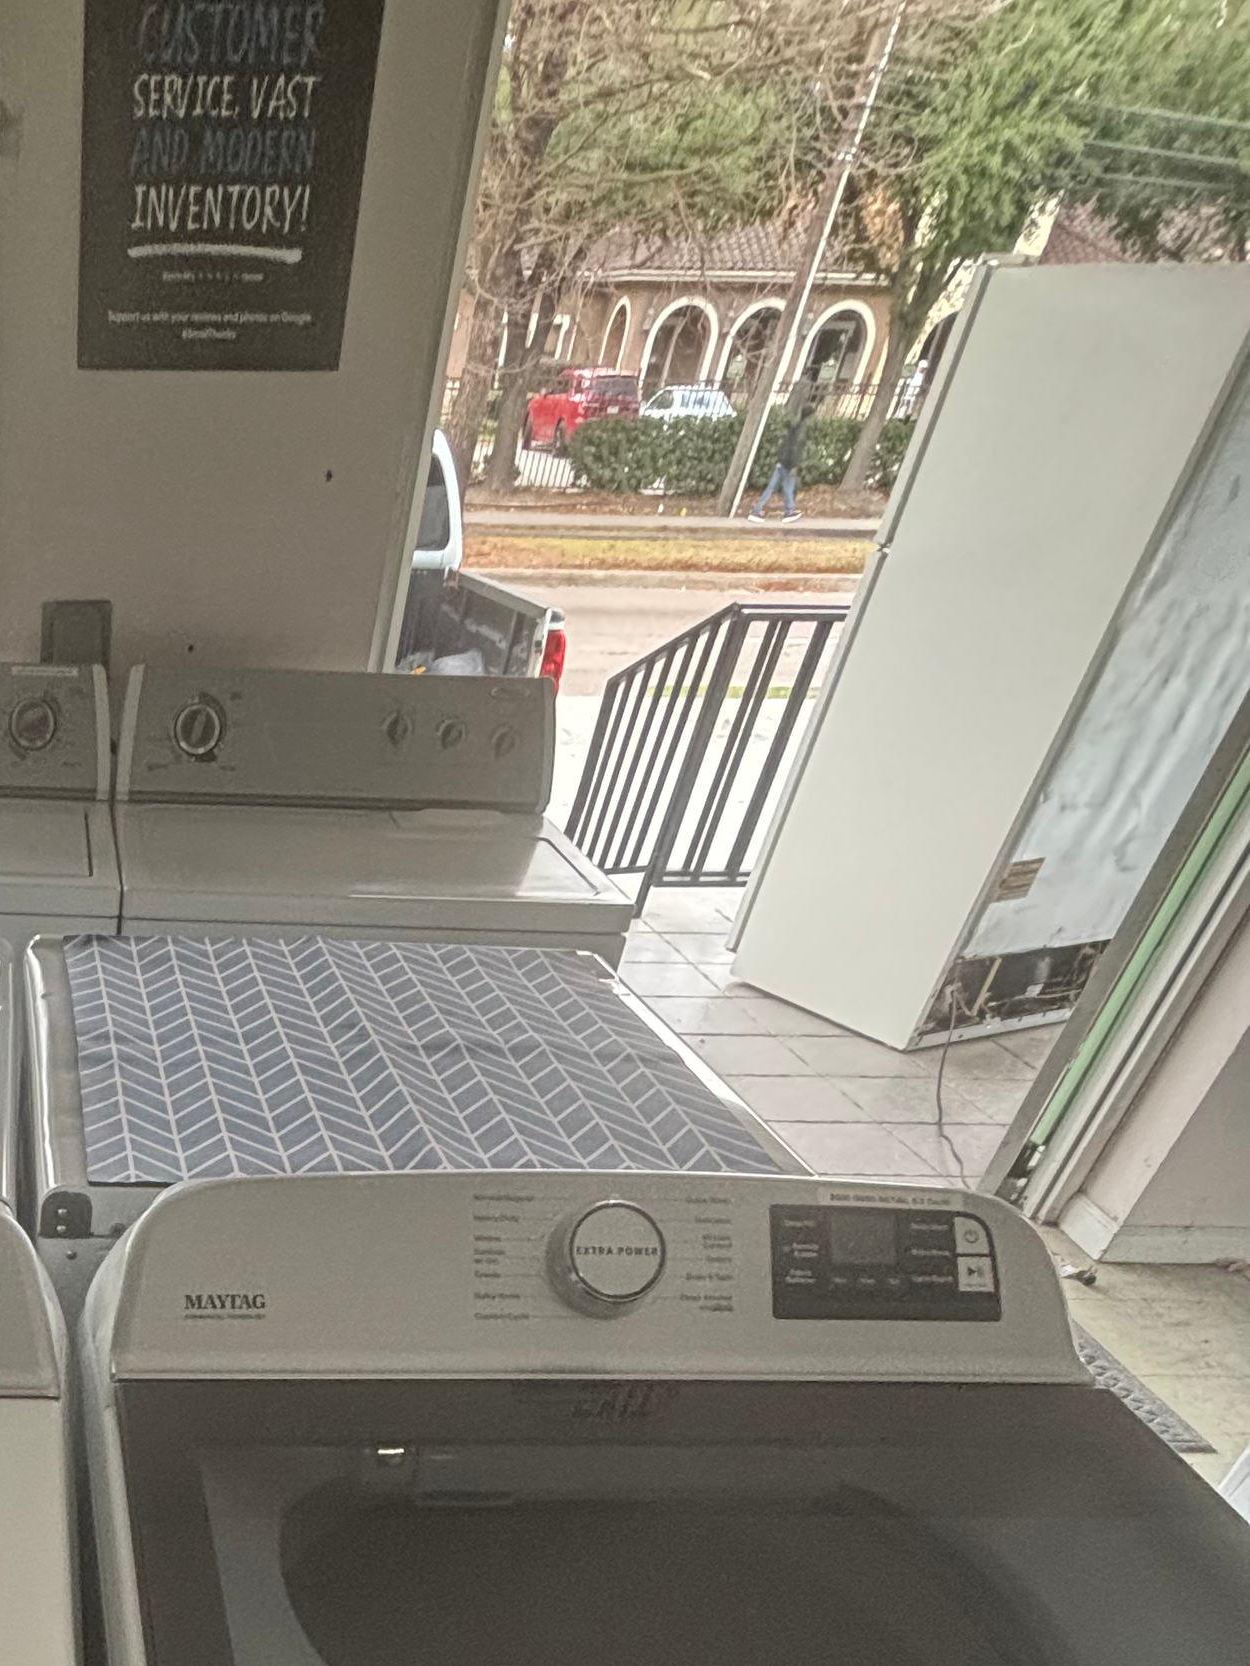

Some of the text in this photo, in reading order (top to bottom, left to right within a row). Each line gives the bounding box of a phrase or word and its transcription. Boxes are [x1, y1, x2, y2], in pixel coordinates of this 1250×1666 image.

[137, 0, 326, 67] CUSTOMER
[251, 72, 323, 120] VAST
[131, 126, 317, 177] AND MODERN
[130, 184, 310, 234] INVENTORY!
[108, 310, 140, 325] Support
[171, 313, 190, 325] your
[223, 312, 238, 323] and
[576, 1246, 659, 1257] EXTRA POWER
[184, 1293, 266, 1310] MAYTAG
